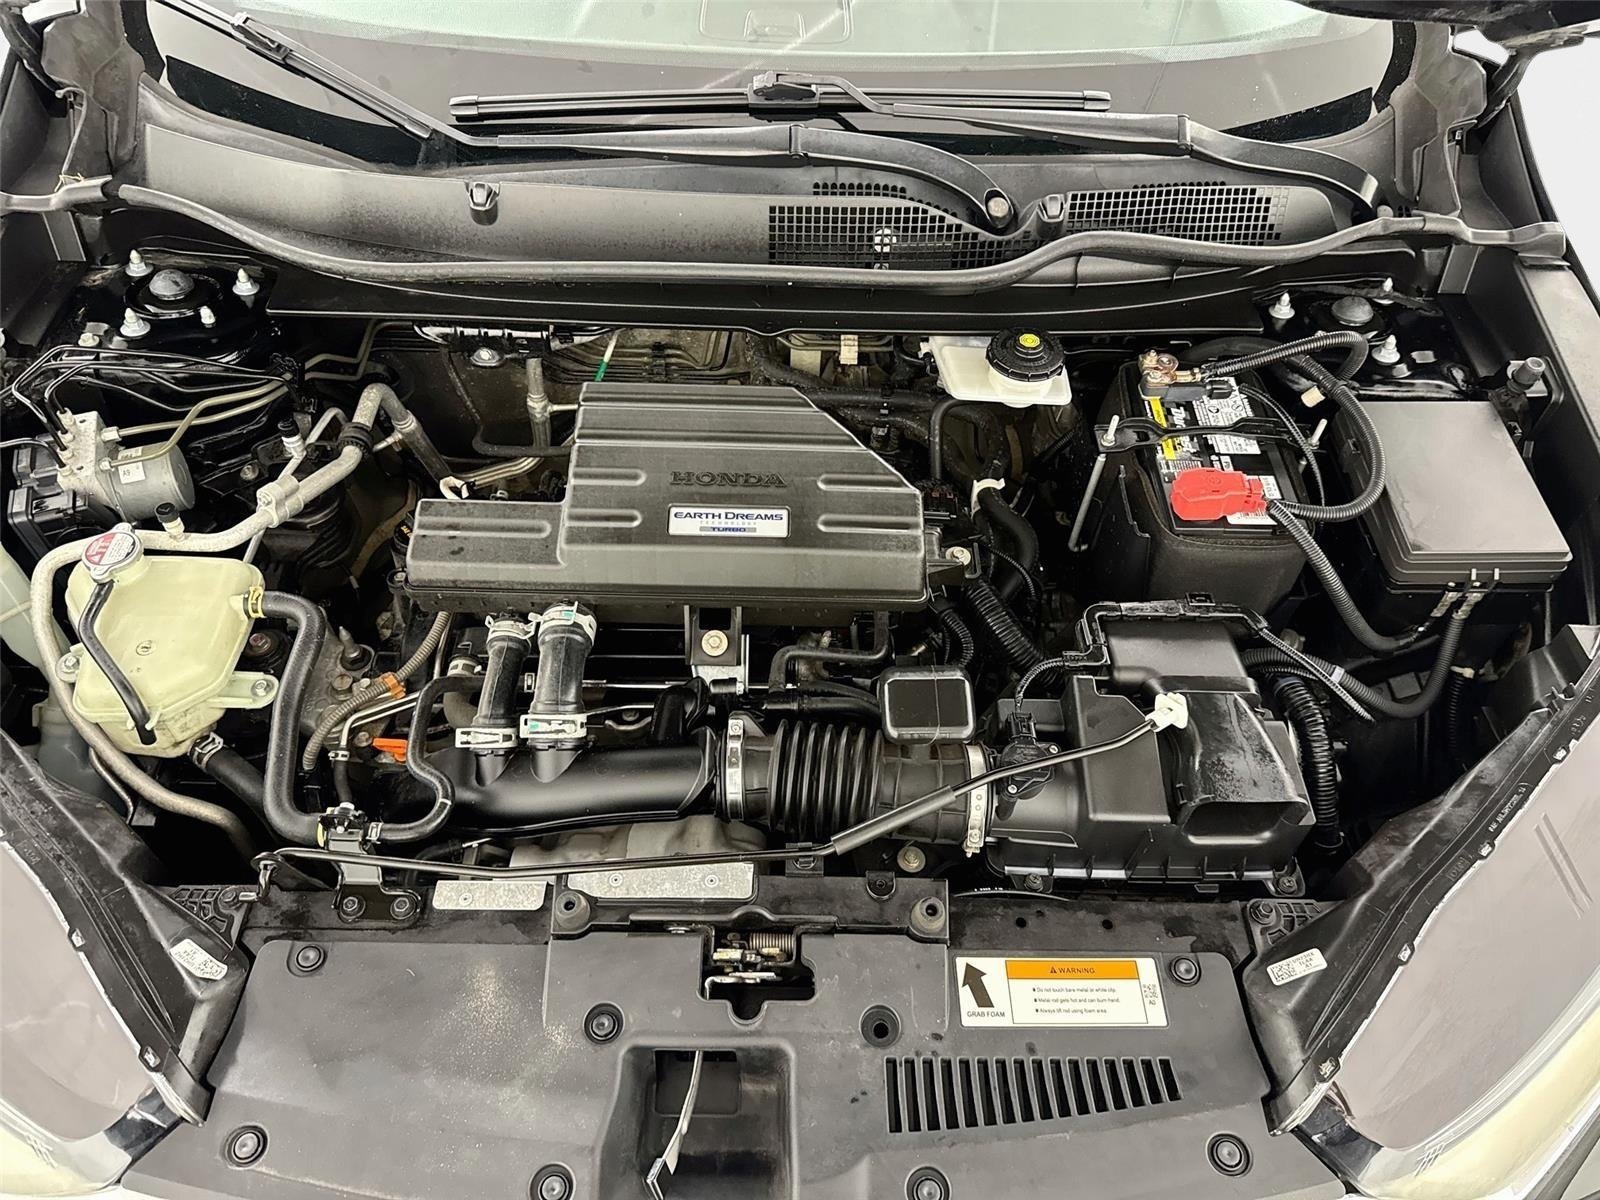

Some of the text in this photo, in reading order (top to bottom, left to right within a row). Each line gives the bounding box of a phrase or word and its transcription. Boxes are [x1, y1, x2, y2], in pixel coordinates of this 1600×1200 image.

[669, 471, 788, 488] HONDA
[674, 511, 783, 521] EARTH DREAMS
